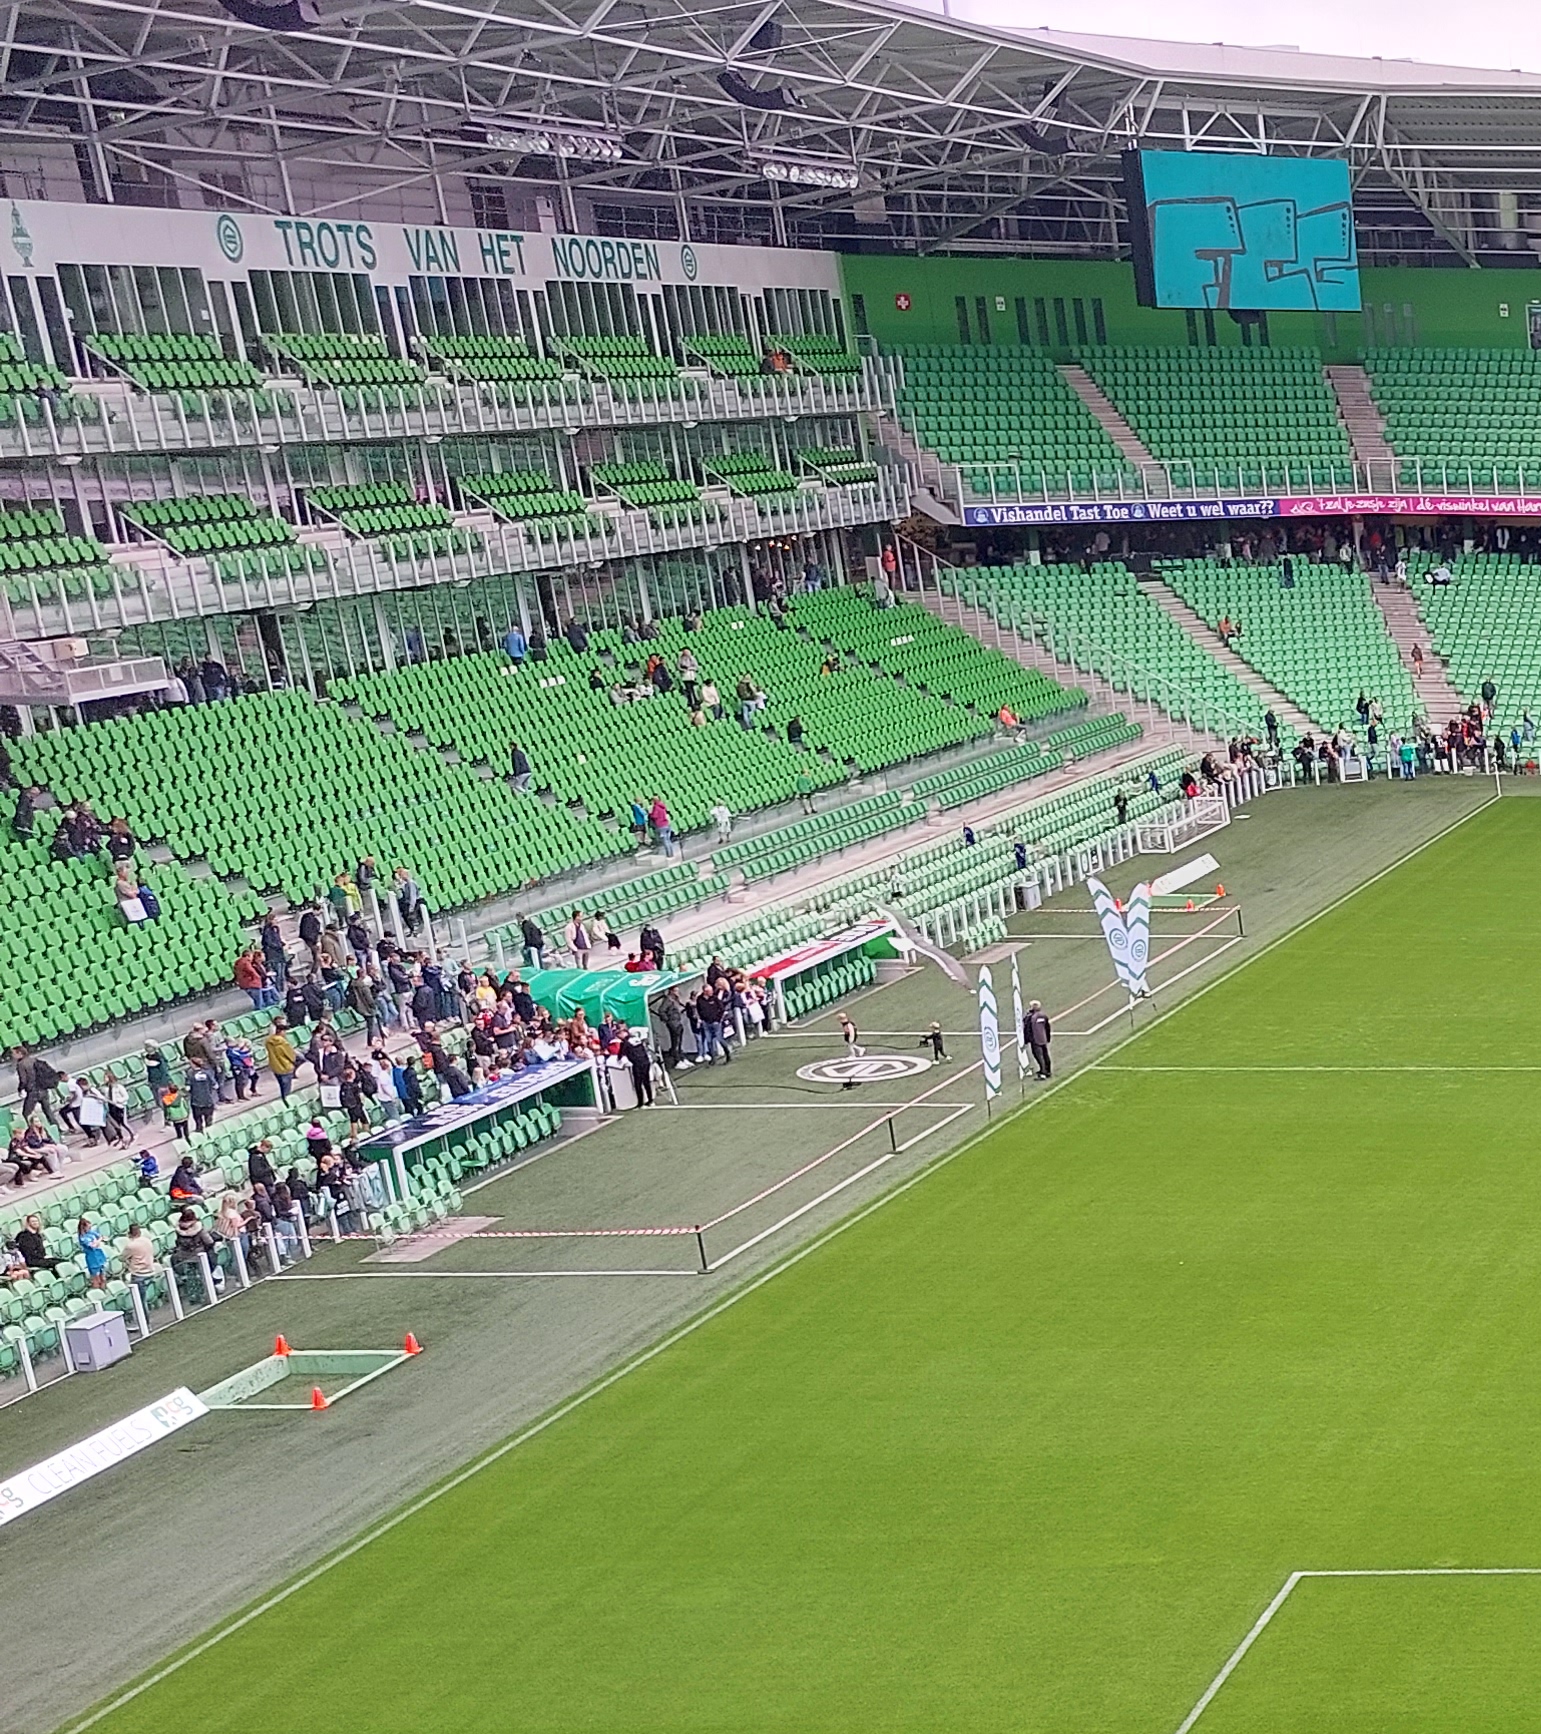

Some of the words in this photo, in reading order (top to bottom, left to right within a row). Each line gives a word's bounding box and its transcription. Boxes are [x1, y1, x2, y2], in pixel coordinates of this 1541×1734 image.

[274, 220, 378, 270] TROTS
[403, 227, 461, 273] VAN
[477, 232, 526, 275] HET
[551, 237, 662, 280] NOORDEN
[989, 505, 1067, 522] Vishandel
[1103, 504, 1130, 519] Toe
[1147, 502, 1183, 518] Weet
[1186, 505, 1197, 517] u
[1200, 501, 1224, 516] wel
[1492, 500, 1515, 512] van
[28, 1453, 98, 1495] CLEAN
[89, 1418, 153, 1463] FUELS
